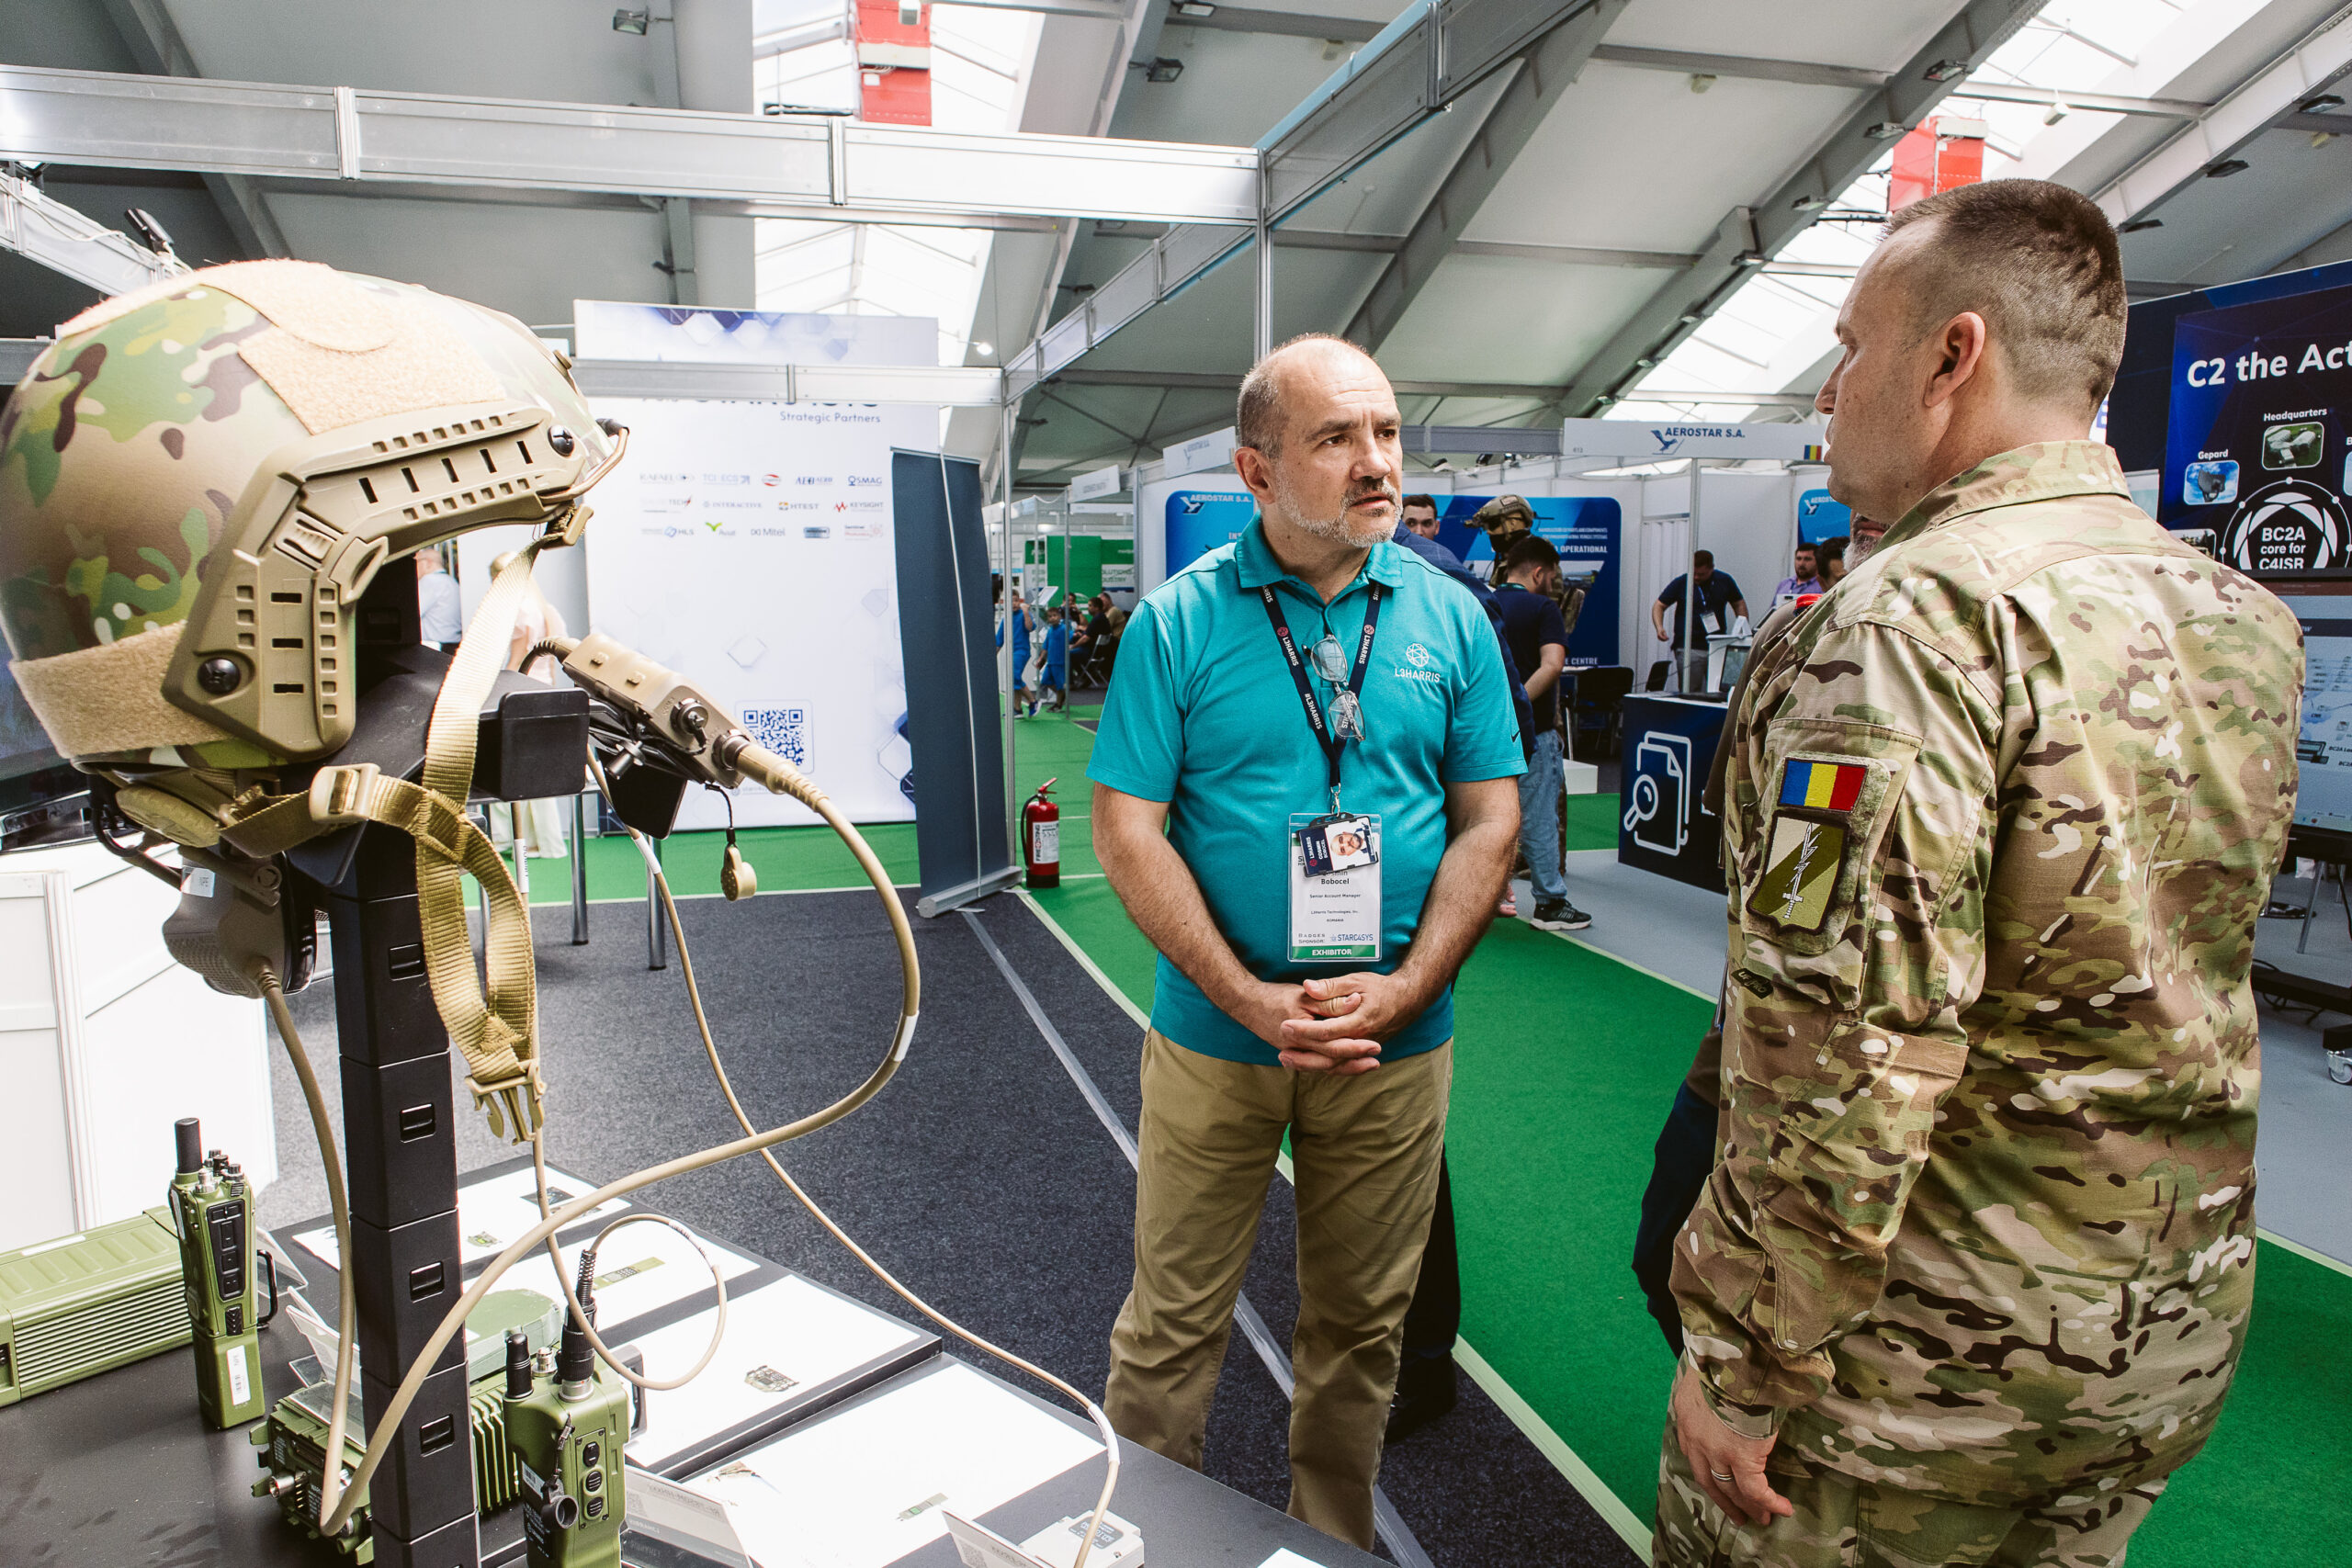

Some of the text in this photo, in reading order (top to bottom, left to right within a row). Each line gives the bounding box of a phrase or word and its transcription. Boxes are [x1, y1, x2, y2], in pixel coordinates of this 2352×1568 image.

[2187, 357, 2226, 389] C2
[2235, 351, 2289, 382] the
[779, 411, 881, 424] Strategic Partners
[2263, 407, 2328, 423] Headquarters
[1665, 426, 1746, 438] AEROSTAR S.A.
[2198, 448, 2229, 460] Gepard
[1190, 494, 1252, 503] AEROSTAR S.A.
[763, 527, 786, 536] Mitel
[2262, 526, 2306, 542] BC2A
[1560, 545, 1608, 554] OPERATIONAL
[2260, 542, 2306, 555] core for
[2259, 557, 2304, 570] C4ISR
[1282, 636, 1299, 666] L3HARRIS
[1358, 635, 1371, 665] L3HARRIS
[1571, 657, 1599, 665] CENTRE
[1395, 667, 1441, 683] L3HARRIS
[1304, 693, 1323, 730] #L3HARRIS
[1337, 933, 1374, 942] STARC4SYS
[1311, 948, 1352, 956] EXHIBITOR
